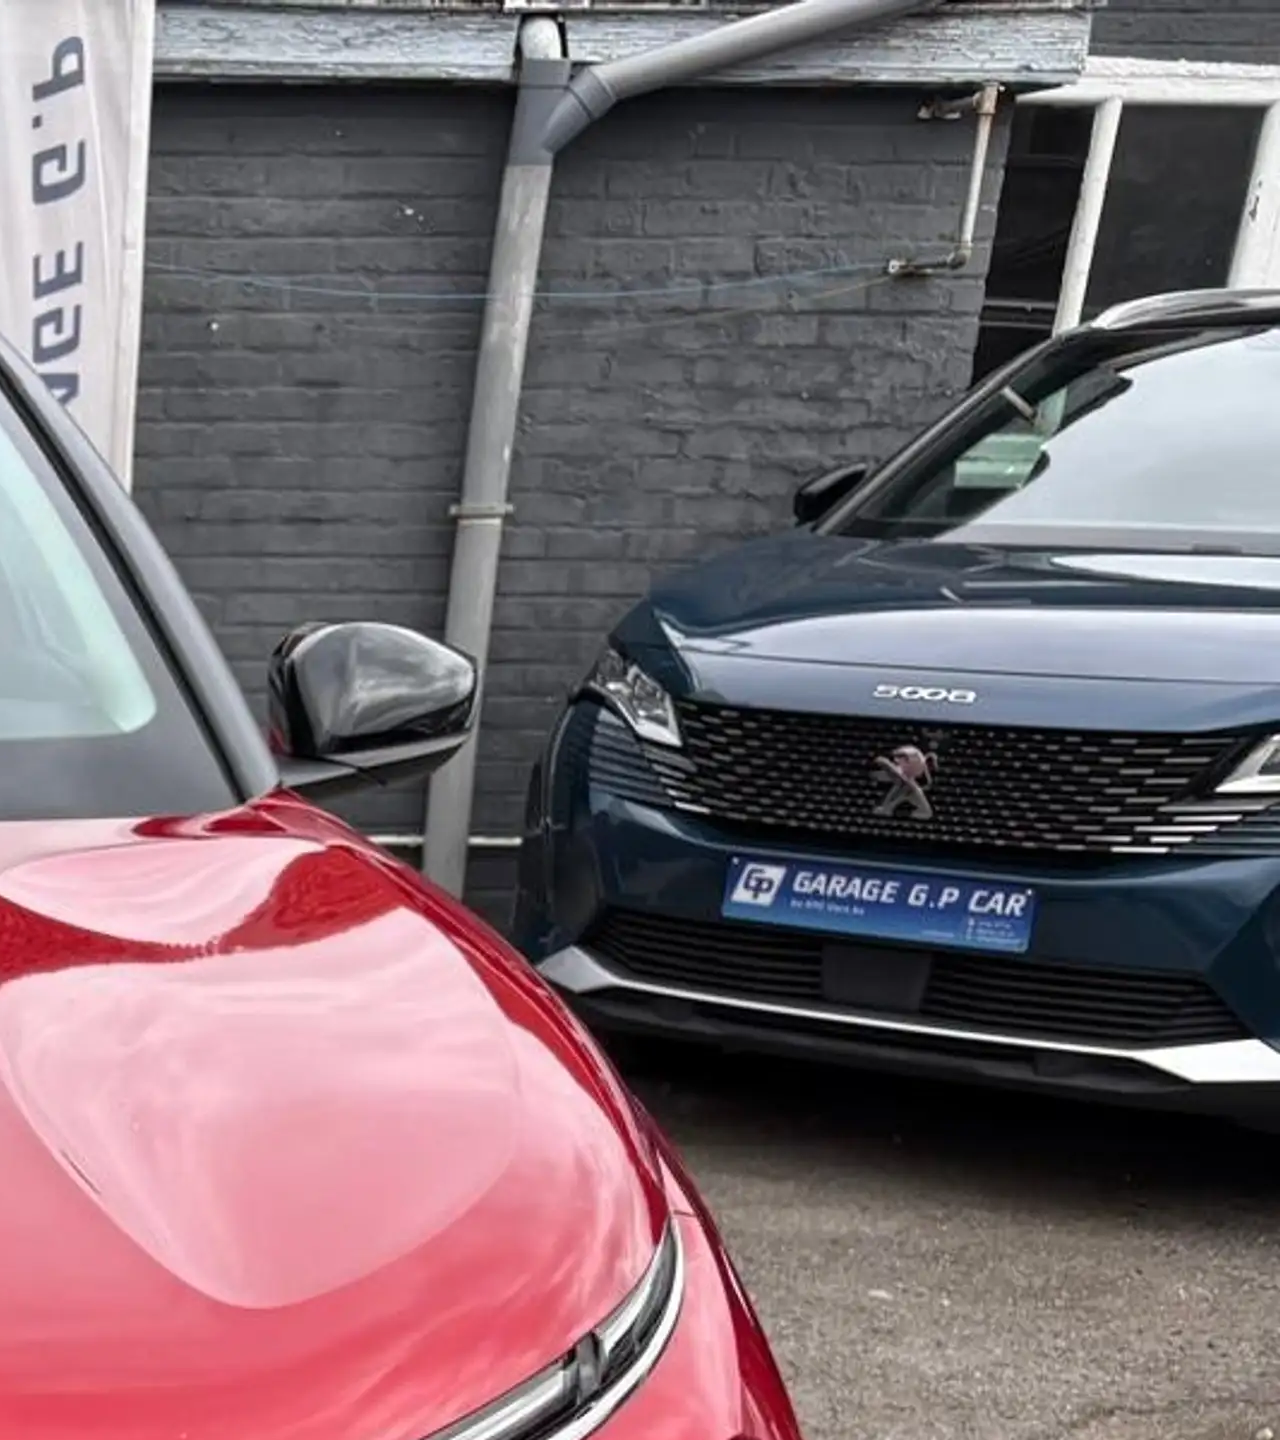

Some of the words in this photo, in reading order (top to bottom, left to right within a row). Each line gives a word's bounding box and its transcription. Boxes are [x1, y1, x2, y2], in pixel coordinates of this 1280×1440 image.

[793, 871, 901, 904] GARAGE
[908, 883, 960, 910] G.P
[968, 889, 1026, 917] CAR
